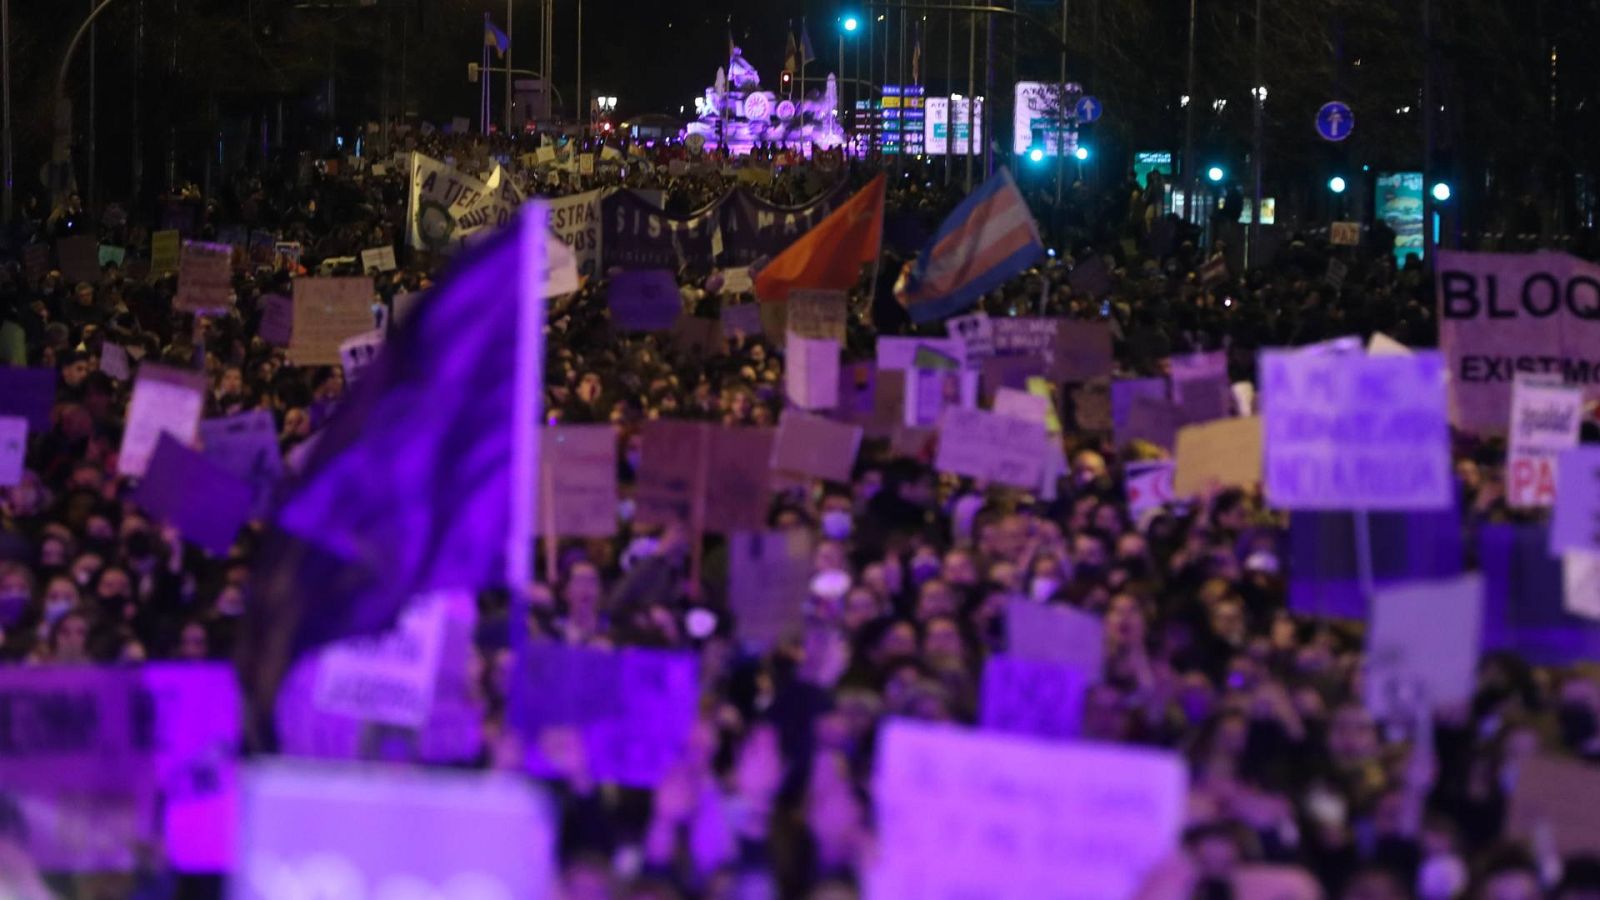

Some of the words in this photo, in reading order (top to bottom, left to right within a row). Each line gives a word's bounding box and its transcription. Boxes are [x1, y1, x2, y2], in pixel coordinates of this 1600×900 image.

[444, 178, 482, 209] TIER
[546, 202, 599, 230] ESTRA,
[1441, 270, 1600, 321] BLOQ
